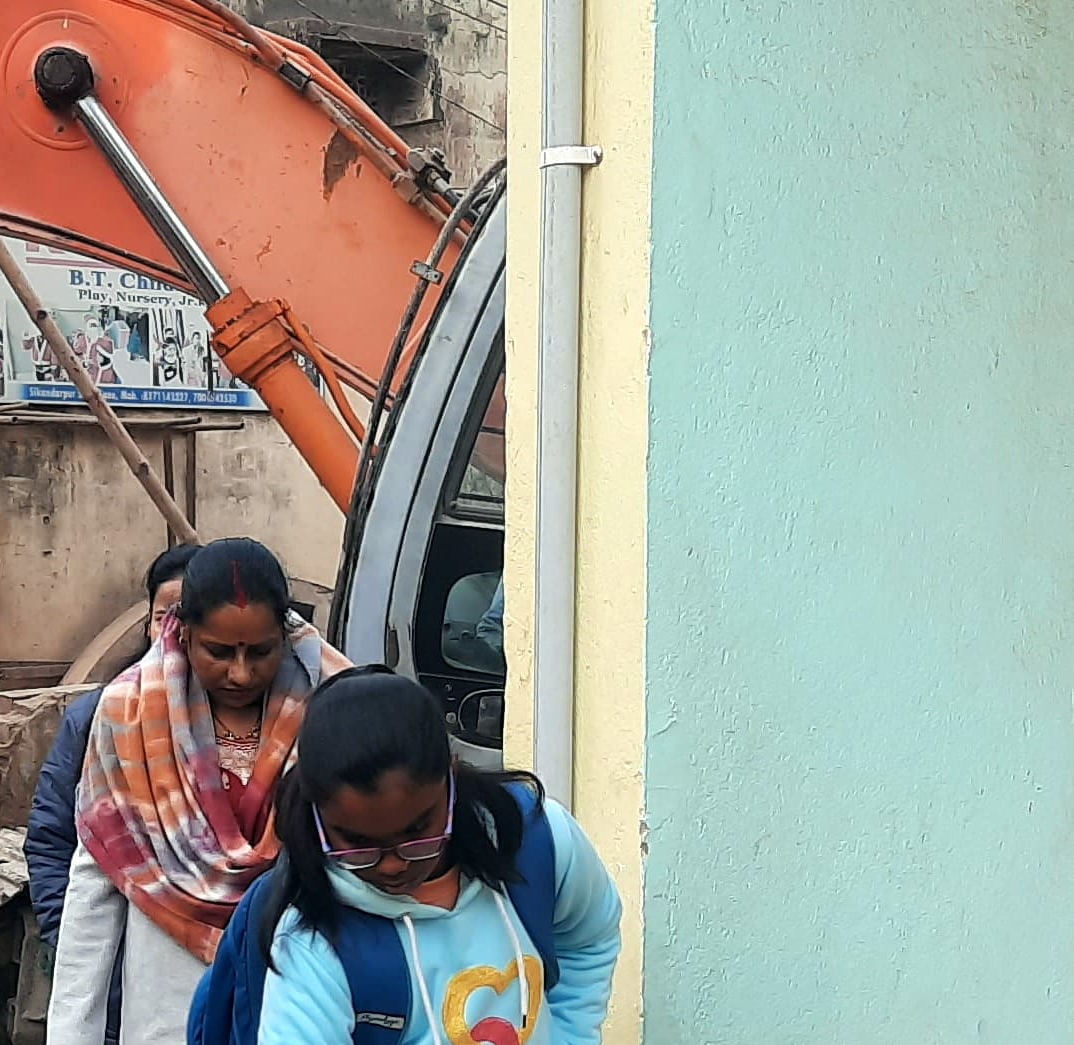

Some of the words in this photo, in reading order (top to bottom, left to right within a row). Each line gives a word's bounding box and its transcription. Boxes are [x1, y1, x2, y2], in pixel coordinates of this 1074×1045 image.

[69, 270, 112, 288] B.T.
[78, 289, 113, 305] Play,
[116, 291, 176, 307] Nursery,
